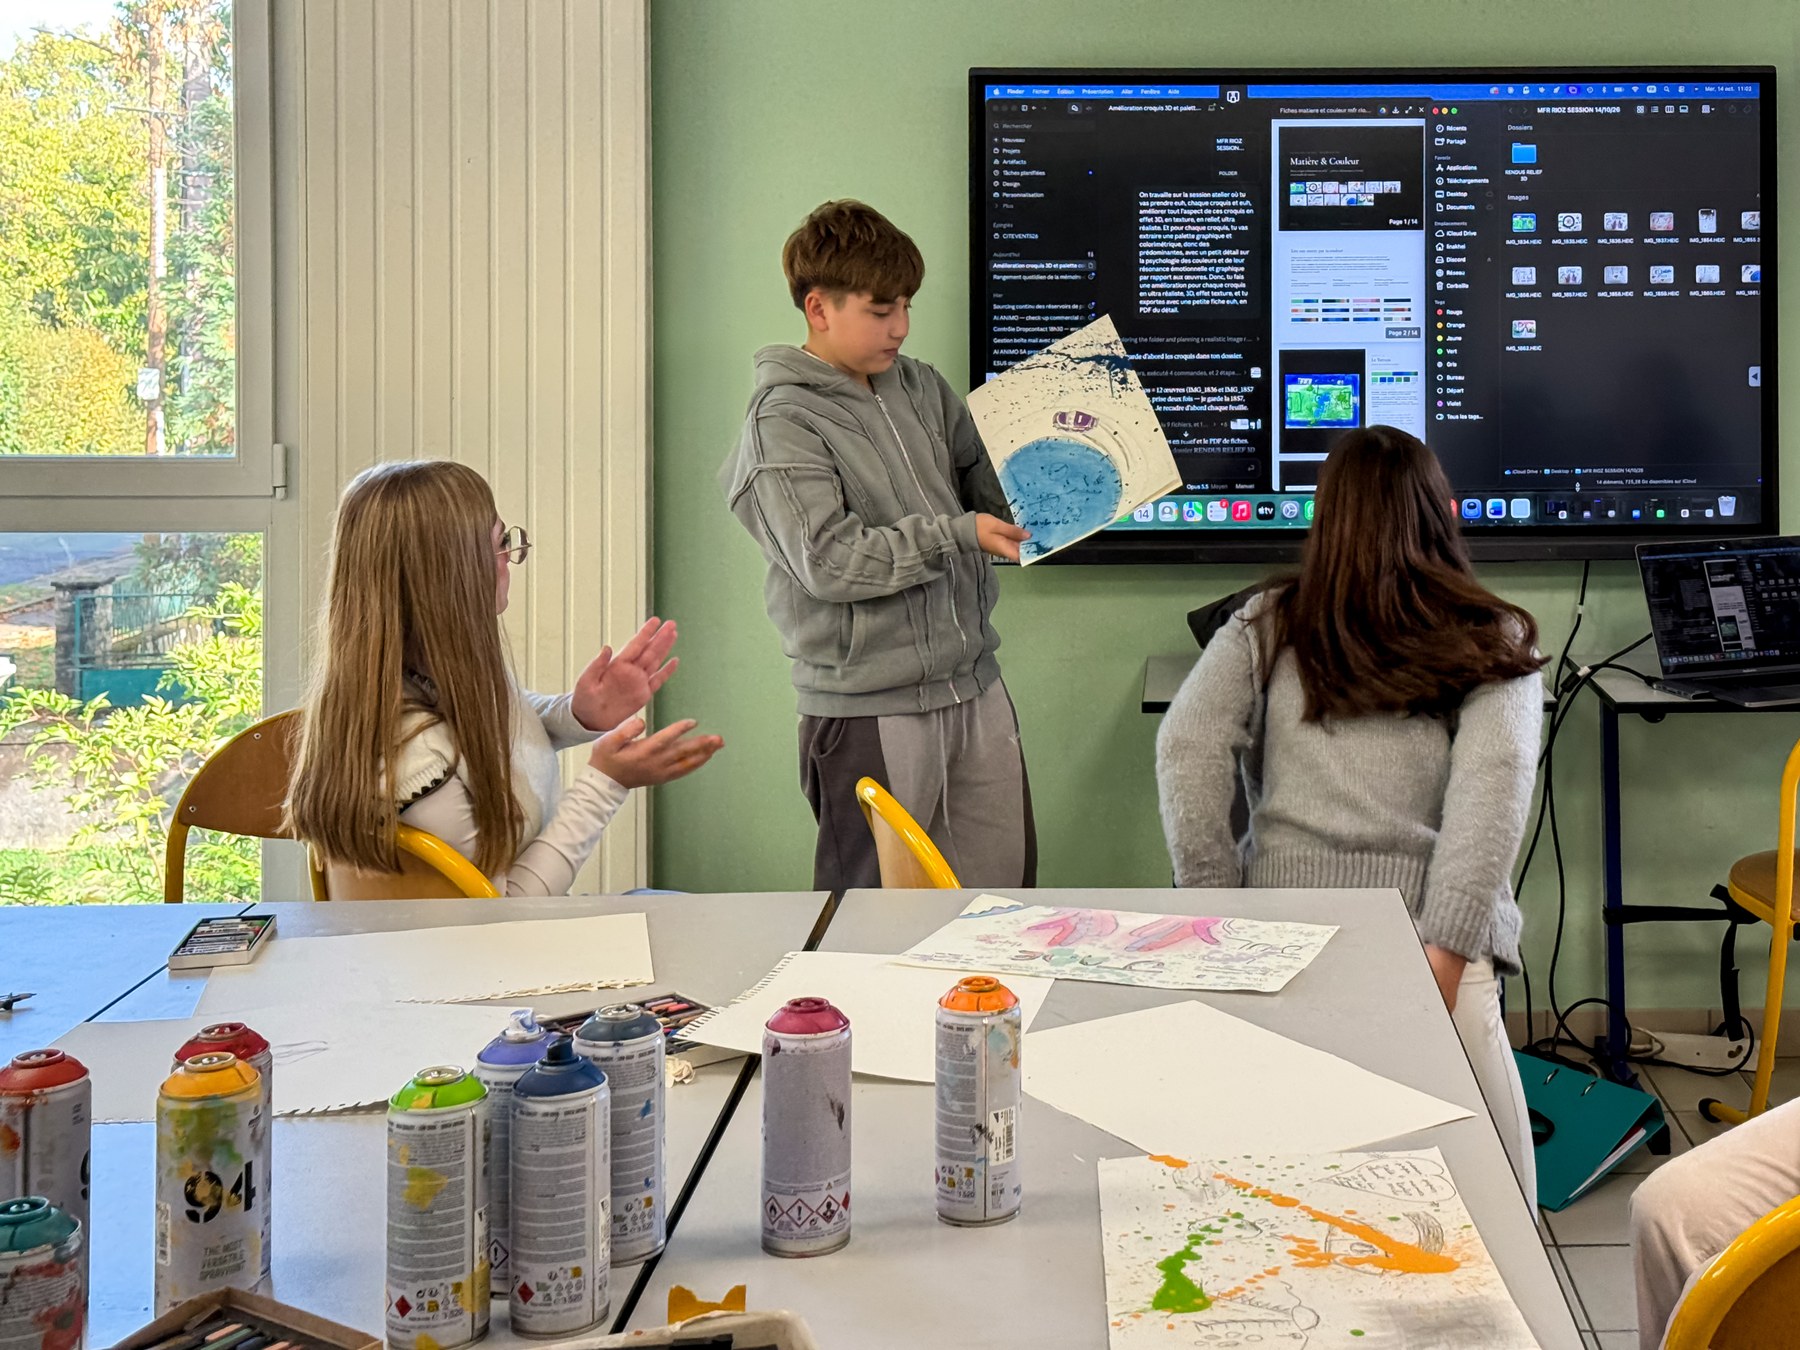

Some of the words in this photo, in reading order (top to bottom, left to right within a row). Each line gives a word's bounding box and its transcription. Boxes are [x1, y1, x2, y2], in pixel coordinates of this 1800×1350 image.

[1150, 200, 1173, 208] prendre
[1188, 200, 1209, 208] chaque
[1210, 200, 1231, 208] croquis
[1181, 208, 1203, 216] l'aspect
[1224, 208, 1245, 216] croquis
[1389, 218, 1402, 226] Page
[1185, 224, 1206, 232] chaque
[1174, 233, 1195, 241] palette
[1196, 233, 1225, 241] graphique
[1146, 257, 1180, 265] psychologie
[1216, 265, 1245, 273] graphique
[1128, 352, 1142, 361] arde
[1138, 510, 1150, 519] 14
[1265, 506, 1273, 515] tv
[184, 1160, 256, 1224] 94
